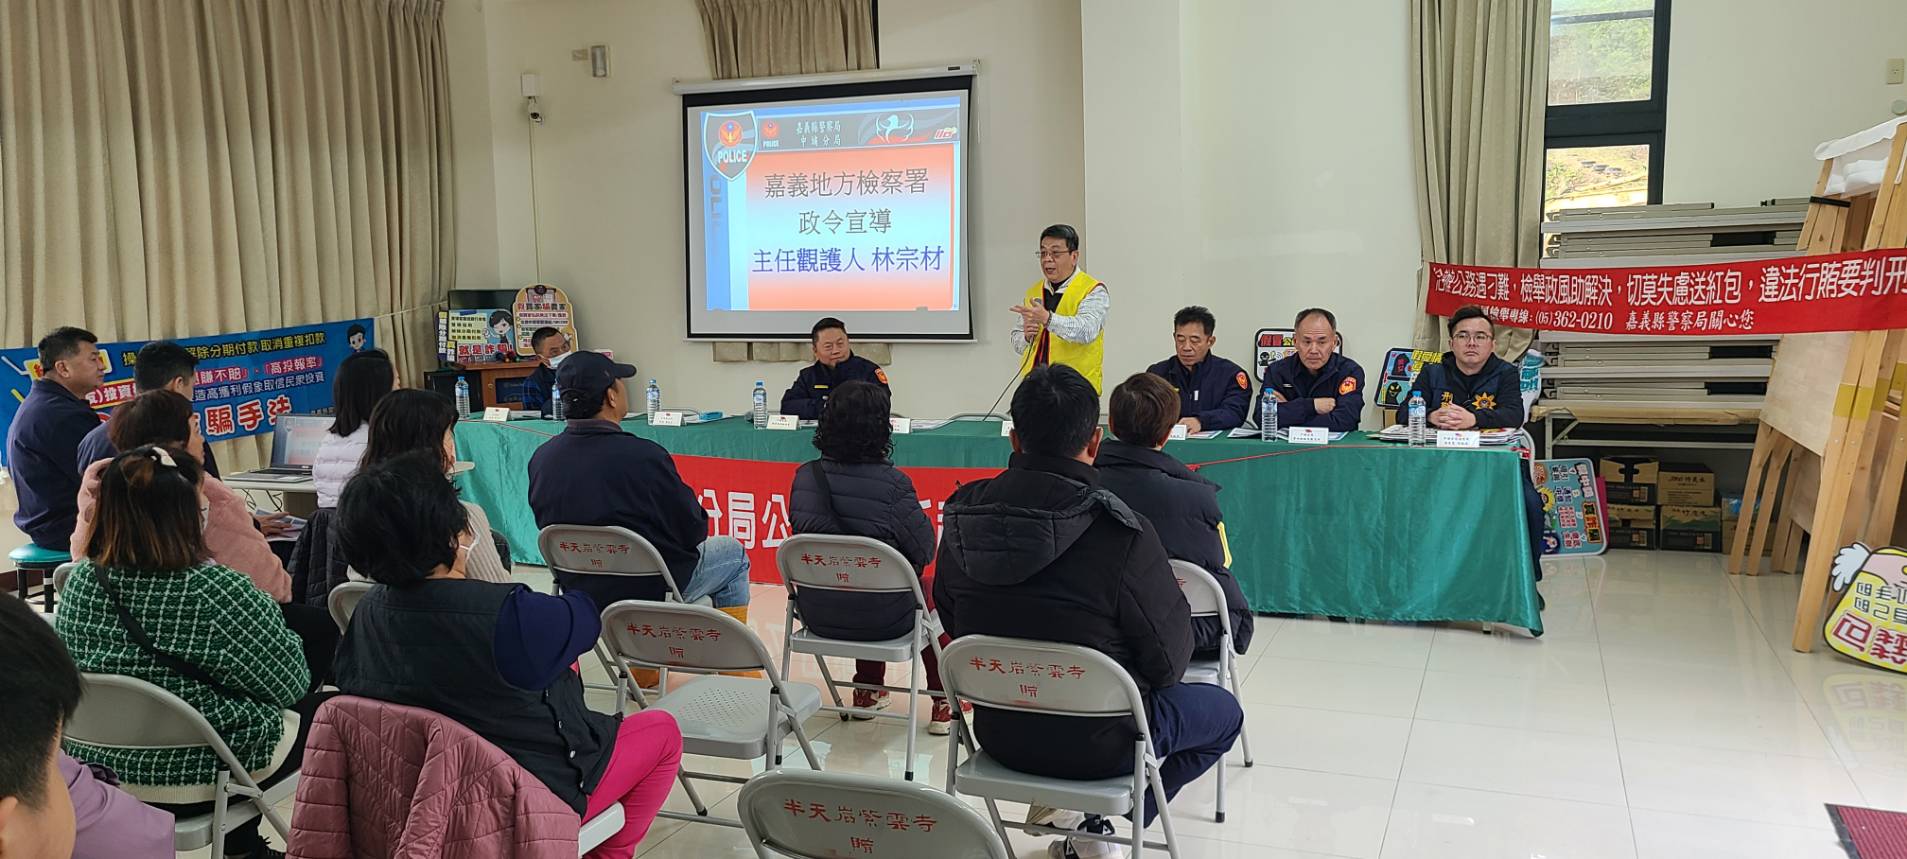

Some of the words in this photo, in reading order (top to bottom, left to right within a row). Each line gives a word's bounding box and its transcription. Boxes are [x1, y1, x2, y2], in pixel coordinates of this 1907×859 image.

[717, 149, 748, 164] POLICE
[762, 140, 779, 148] POLICE
[764, 168, 929, 198] 嘉義地方檢察署
[798, 208, 892, 235] 政令宣導
[751, 247, 865, 273] 主任觀護人
[871, 245, 945, 272] 林宗材
[1625, 309, 1755, 332] 嘉義縣警察局關心您
